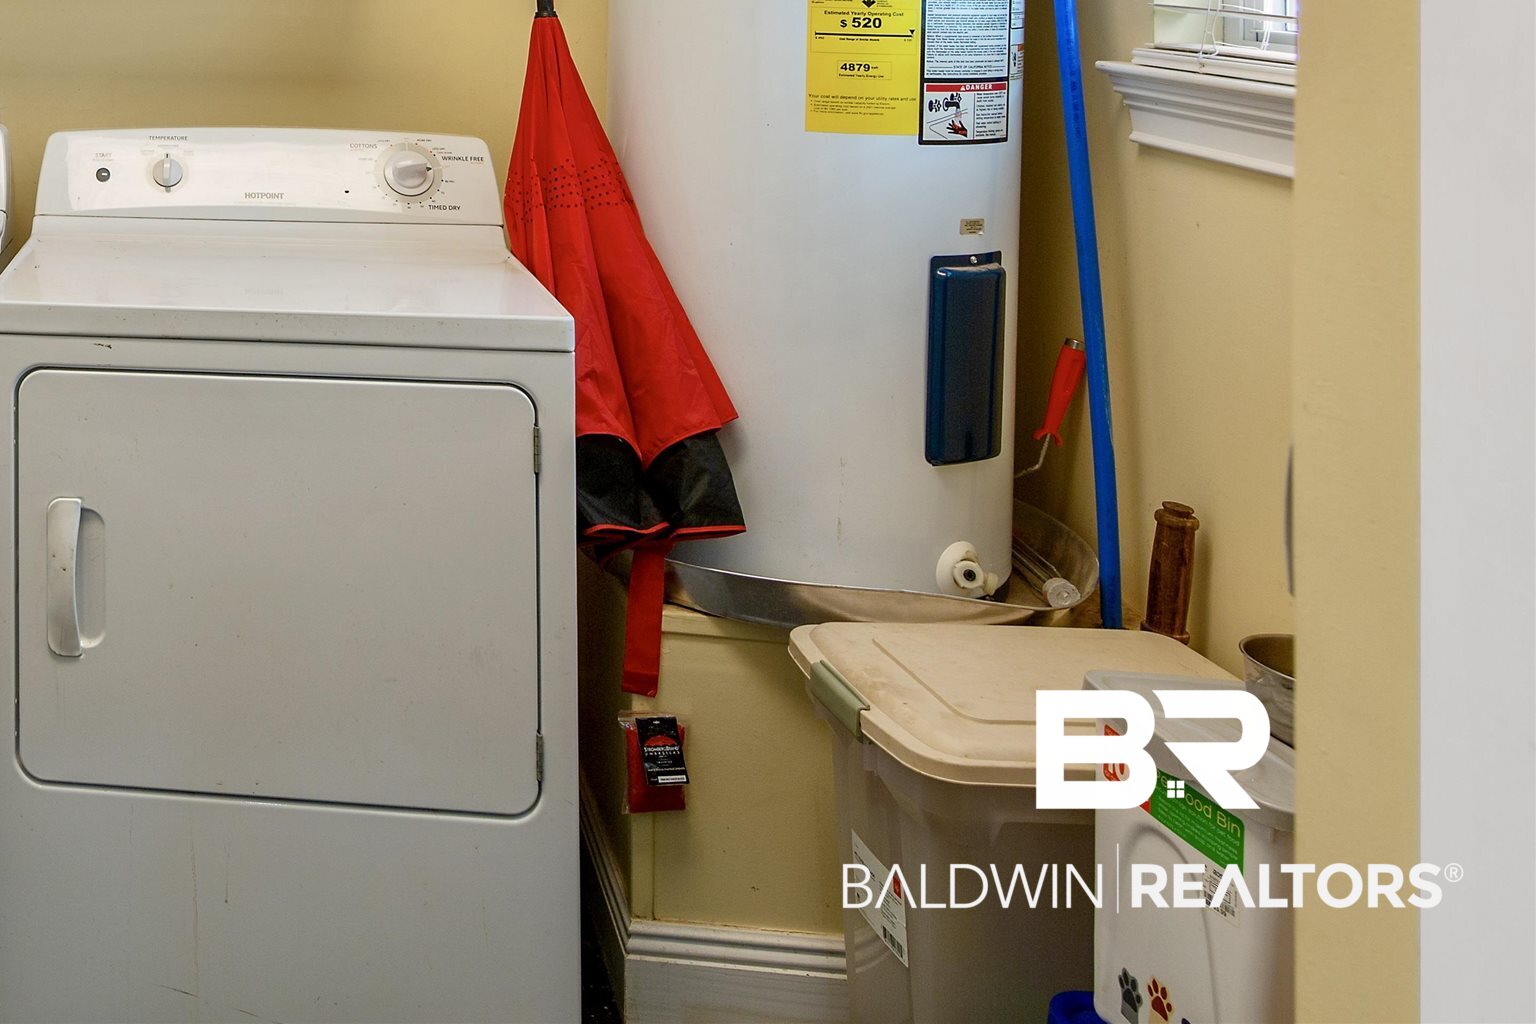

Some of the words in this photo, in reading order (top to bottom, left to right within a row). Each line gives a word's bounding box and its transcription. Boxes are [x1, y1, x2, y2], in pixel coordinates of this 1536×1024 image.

[840, 19, 848, 28] $
[851, 17, 882, 29] 520
[840, 63, 871, 72] 4879
[1184, 793, 1212, 819] ood
[1216, 811, 1241, 838] Bin
